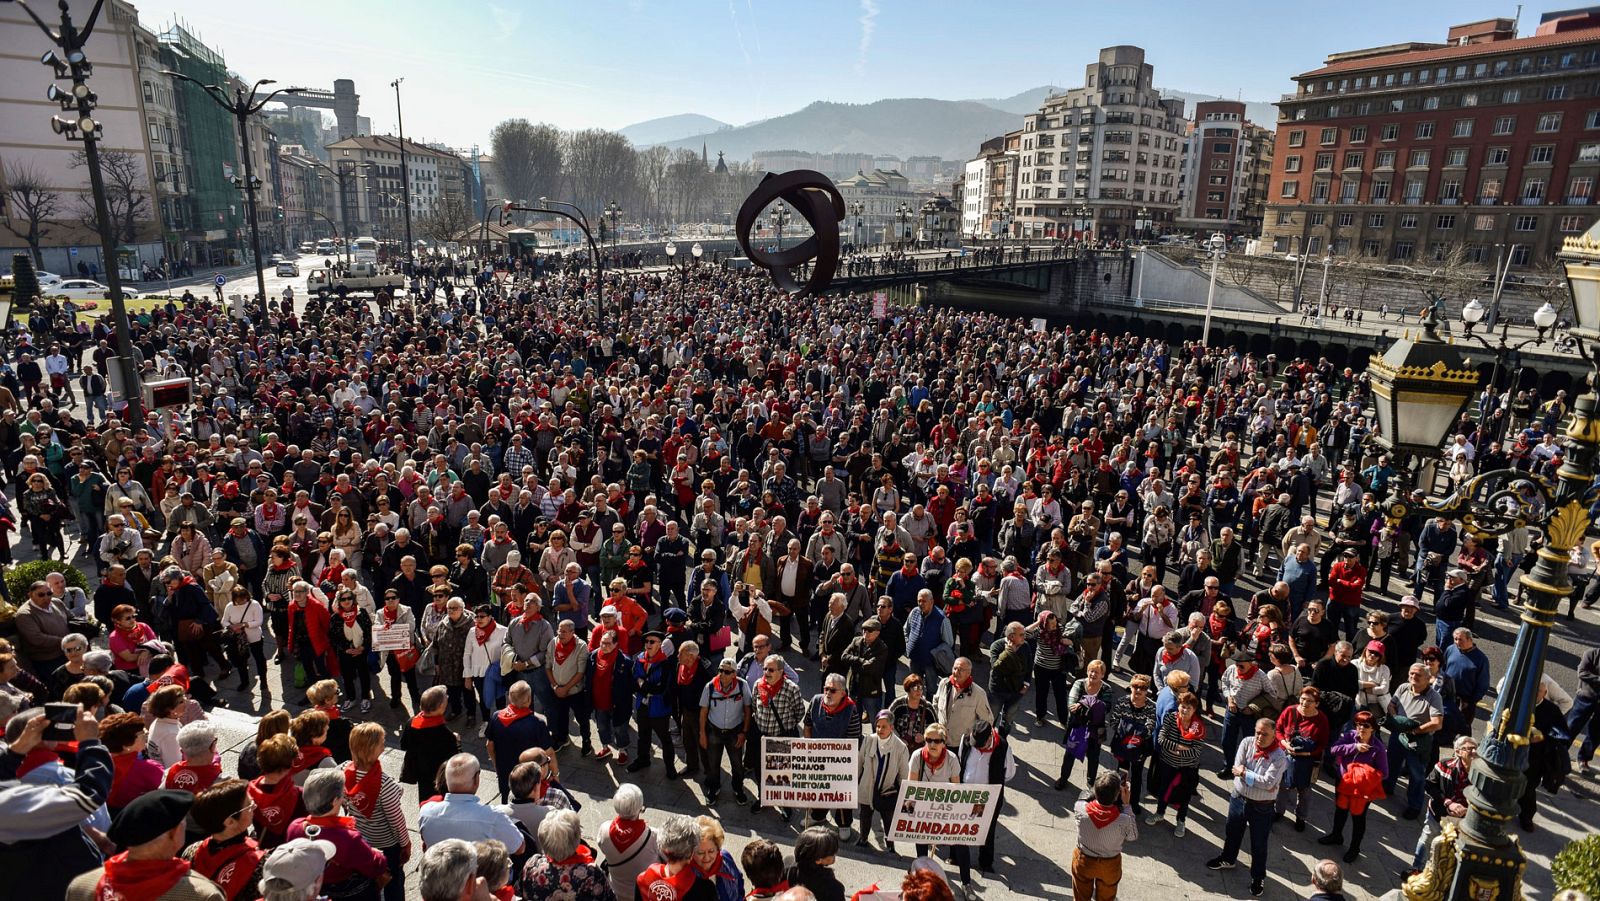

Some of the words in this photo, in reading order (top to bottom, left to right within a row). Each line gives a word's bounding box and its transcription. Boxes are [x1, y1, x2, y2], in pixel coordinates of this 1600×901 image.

[792, 773, 807, 781] POR
[808, 774, 853, 782] NUESTRO/AS
[791, 781, 831, 790] NIETO/AS
[783, 790, 795, 801] UN
[796, 791, 817, 801] PASO
[905, 786, 990, 803] PENSIONES
[930, 802, 954, 811] LAS
[895, 819, 980, 836] BLINDADAS
[905, 832, 942, 841] NUESTRO
